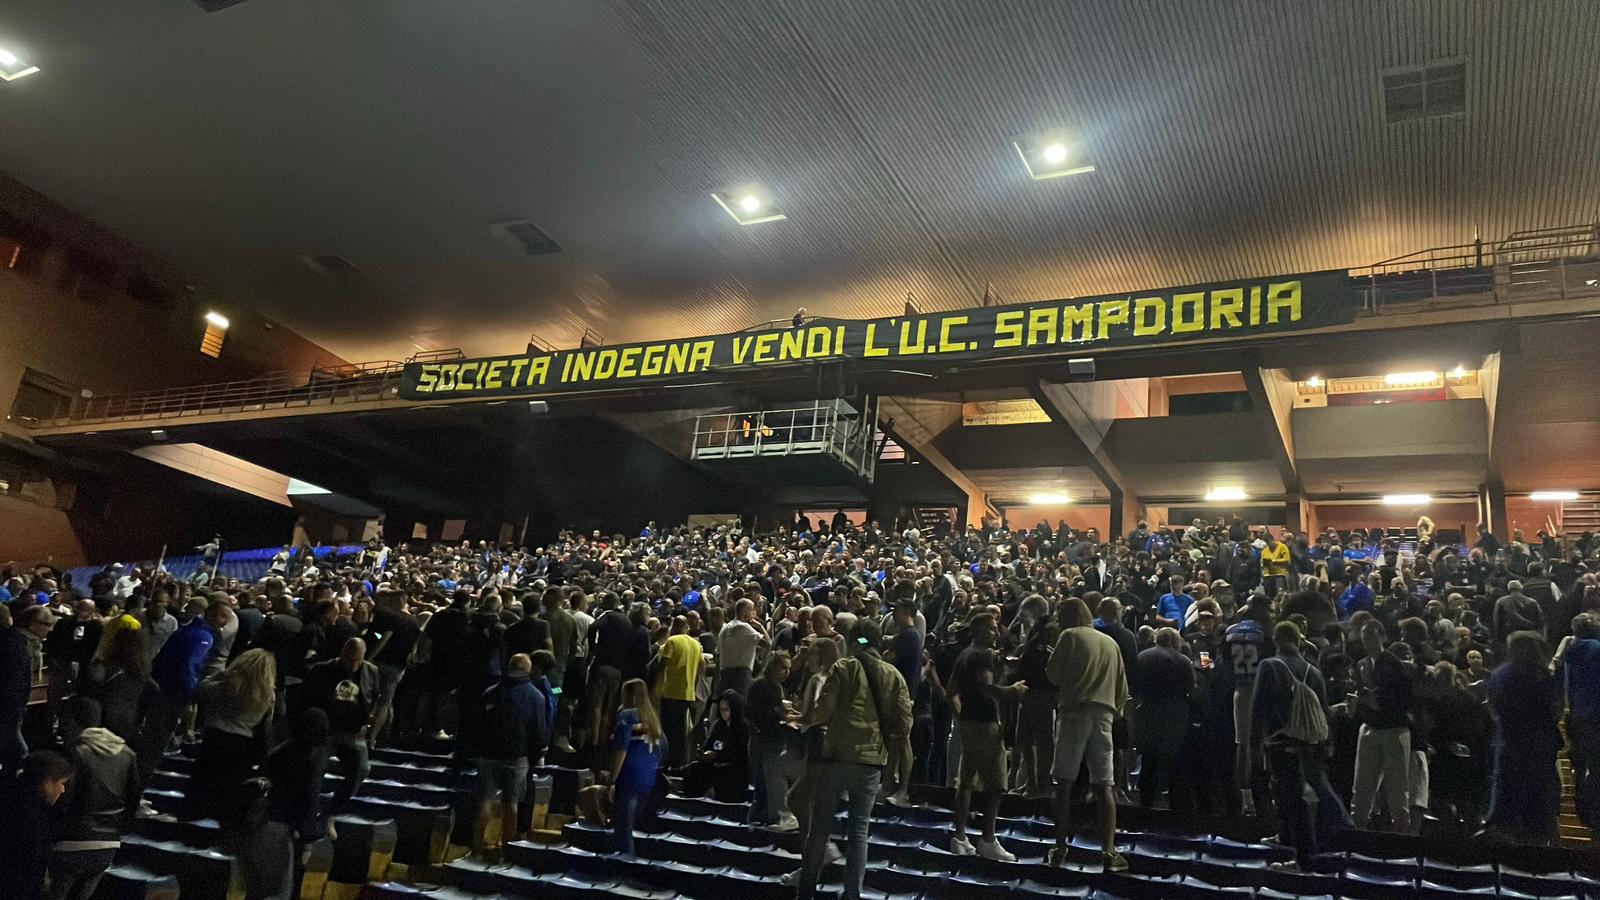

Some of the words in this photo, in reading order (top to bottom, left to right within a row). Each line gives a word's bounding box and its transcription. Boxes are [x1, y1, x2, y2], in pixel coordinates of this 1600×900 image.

[560, 340, 715, 384] INDEGNA
[732, 325, 846, 366] VENDI
[863, 316, 978, 357] L'U.C.
[993, 280, 1303, 349] SAMPDORIA
